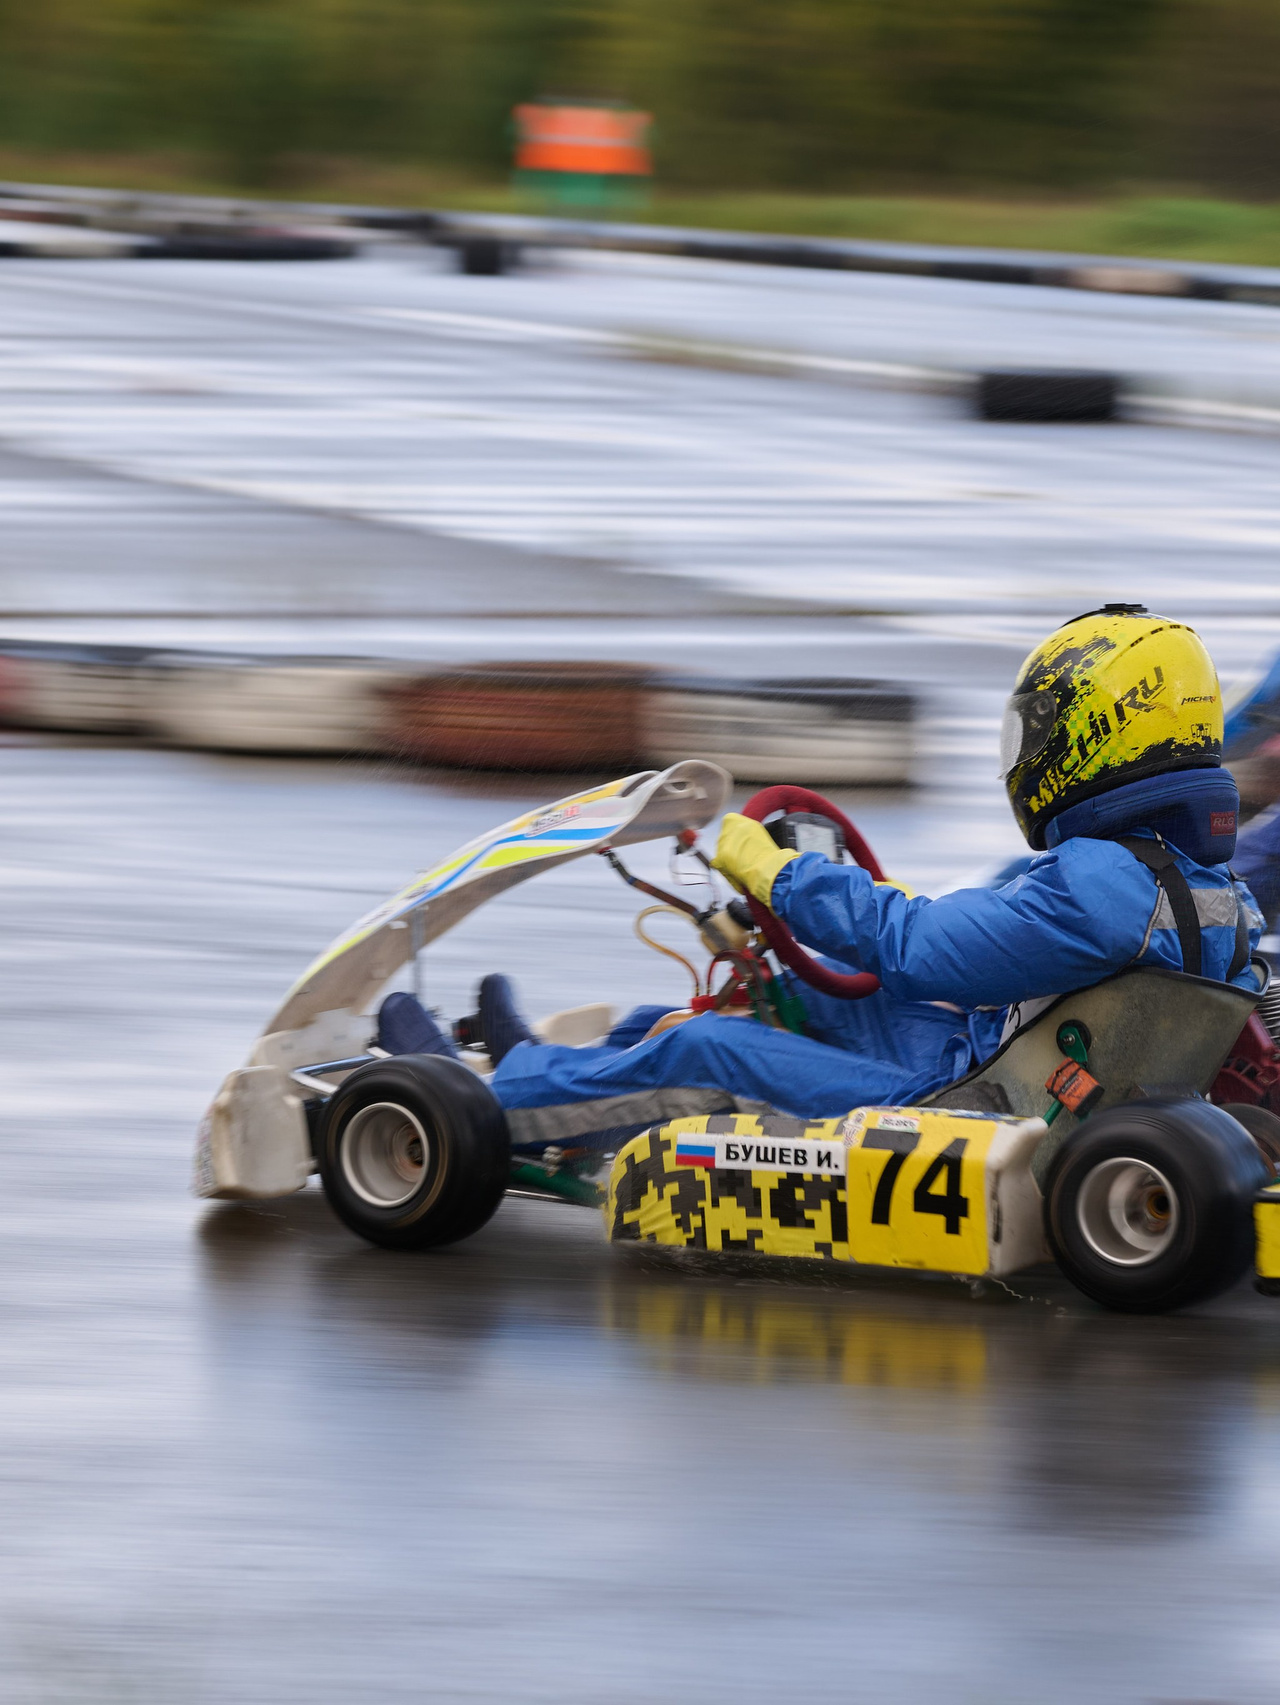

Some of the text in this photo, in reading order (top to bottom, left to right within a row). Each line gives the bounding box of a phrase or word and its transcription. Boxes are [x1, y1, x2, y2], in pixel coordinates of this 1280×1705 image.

[1212, 816, 1234, 827] RLG
[724, 1143, 839, 1170] БУШЕВ И.
[860, 1129, 969, 1235] 74
